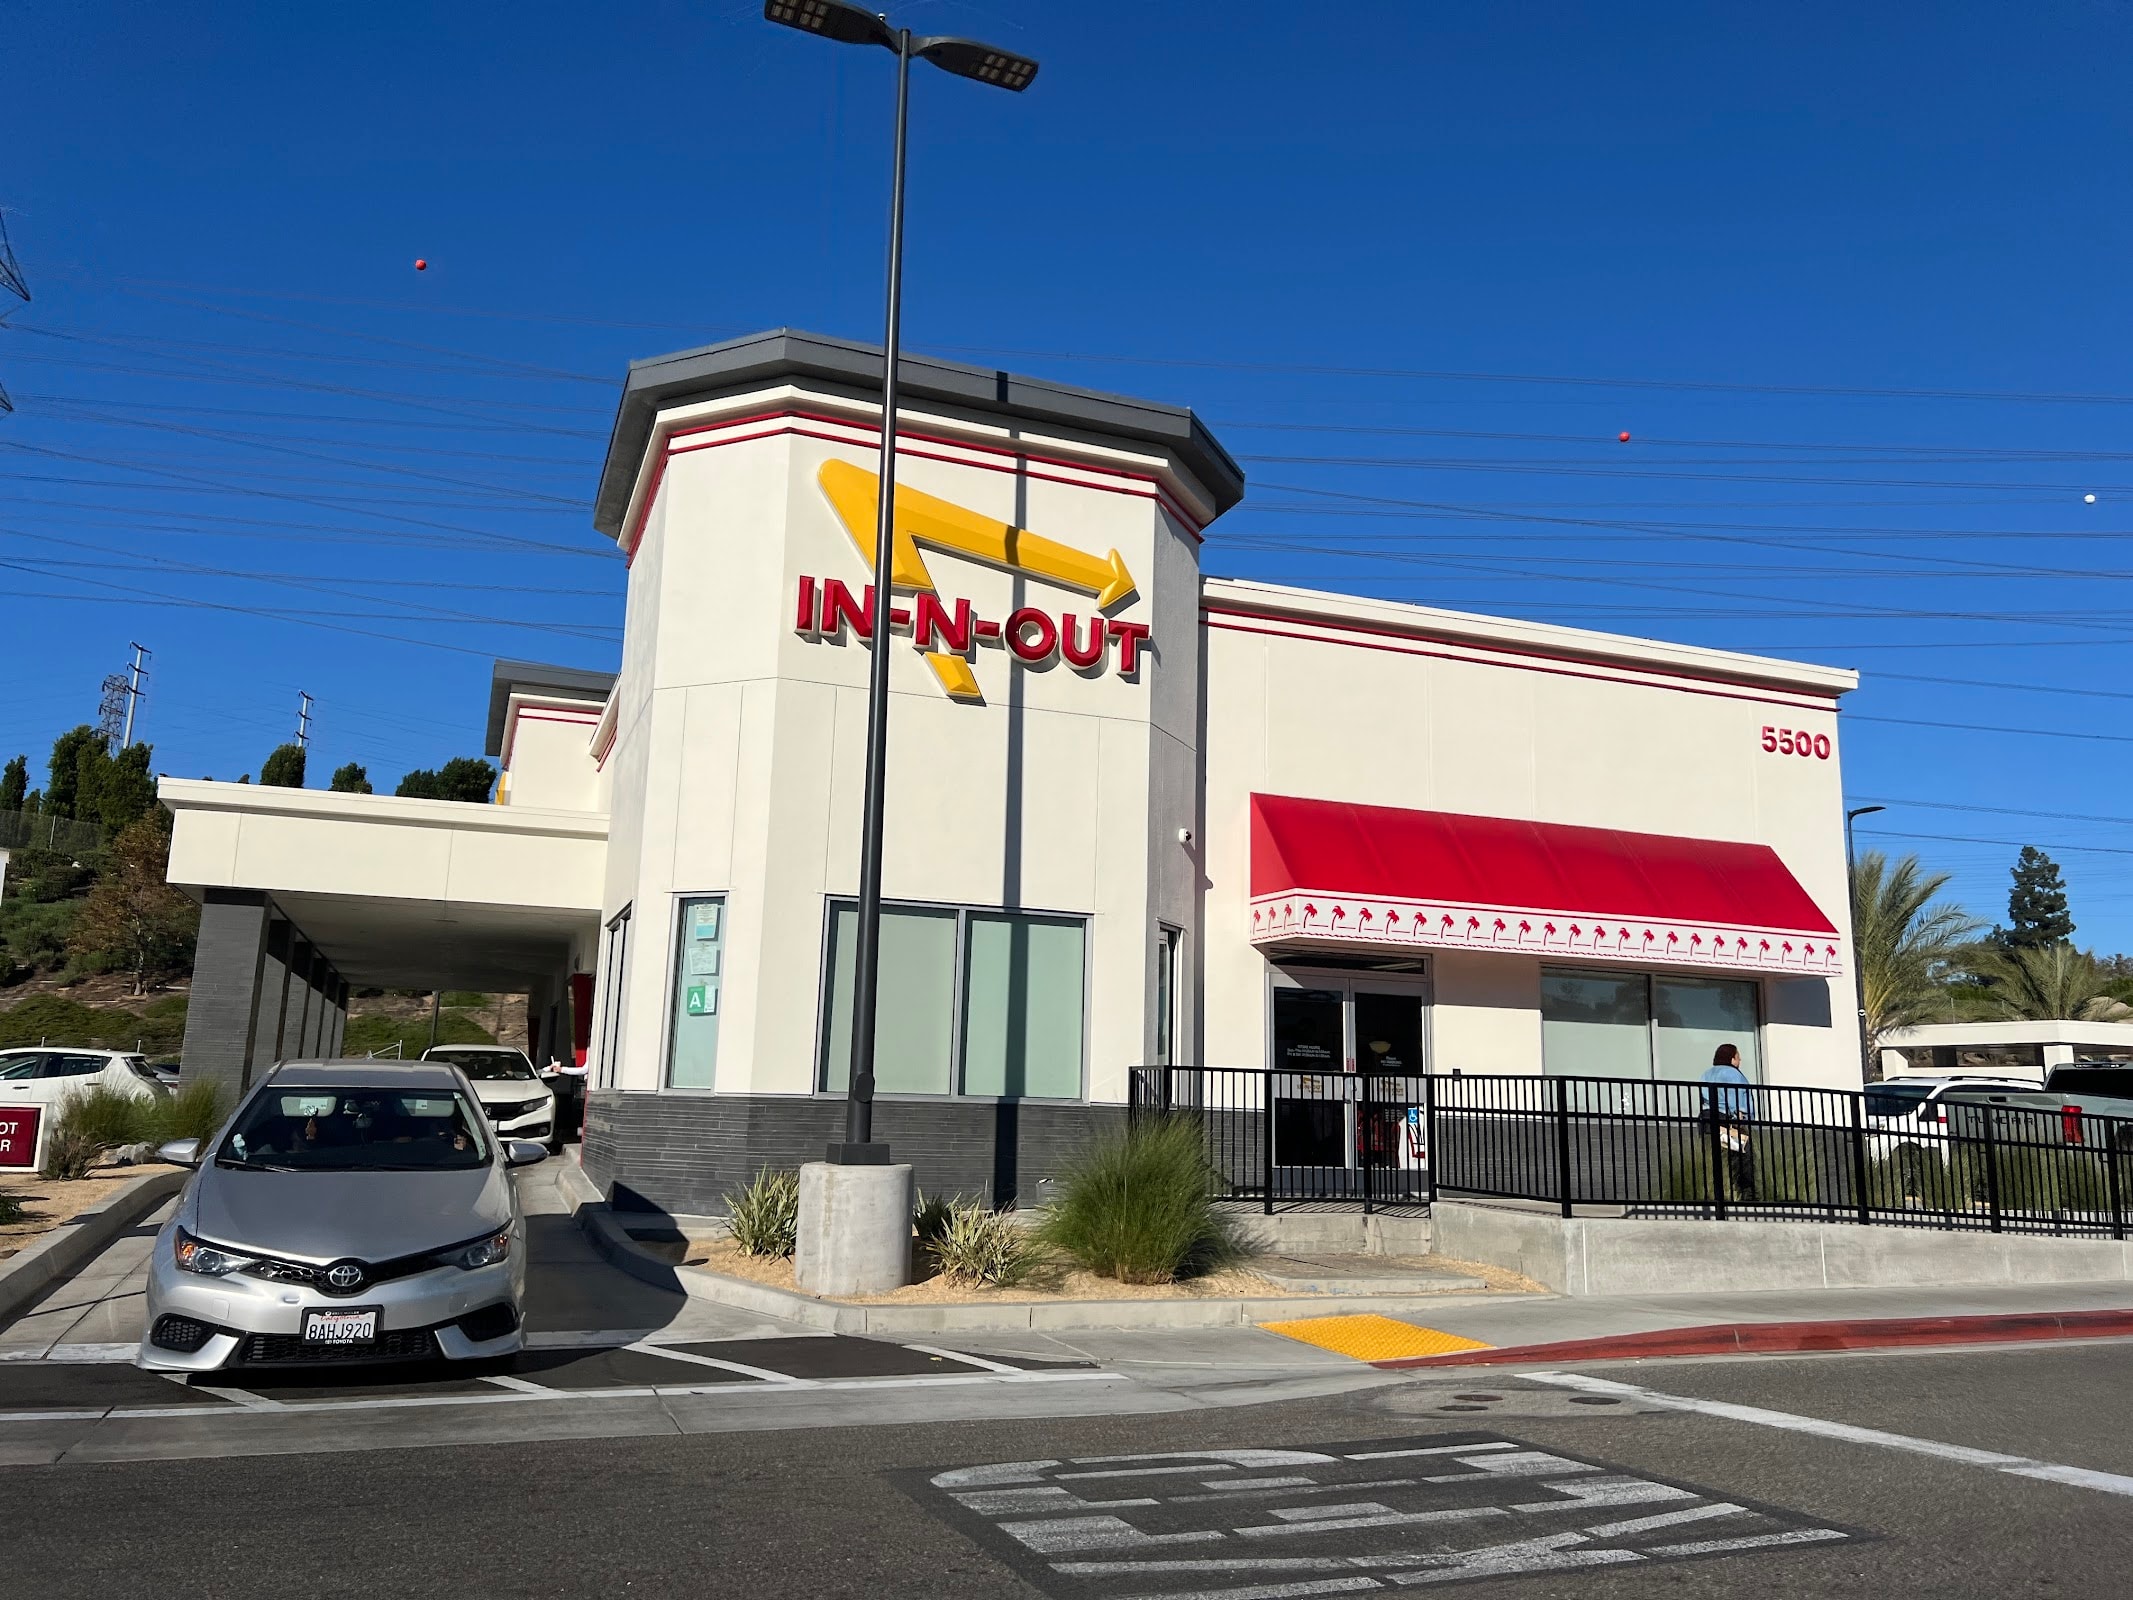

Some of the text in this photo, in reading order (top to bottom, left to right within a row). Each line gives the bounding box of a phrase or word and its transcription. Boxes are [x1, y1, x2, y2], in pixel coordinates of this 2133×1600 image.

[795, 574, 1151, 676] IN-N-OUT
[1761, 725, 1831, 761] 5500
[689, 991, 702, 1009] A
[308, 1322, 371, 1340] 8AHJ920
